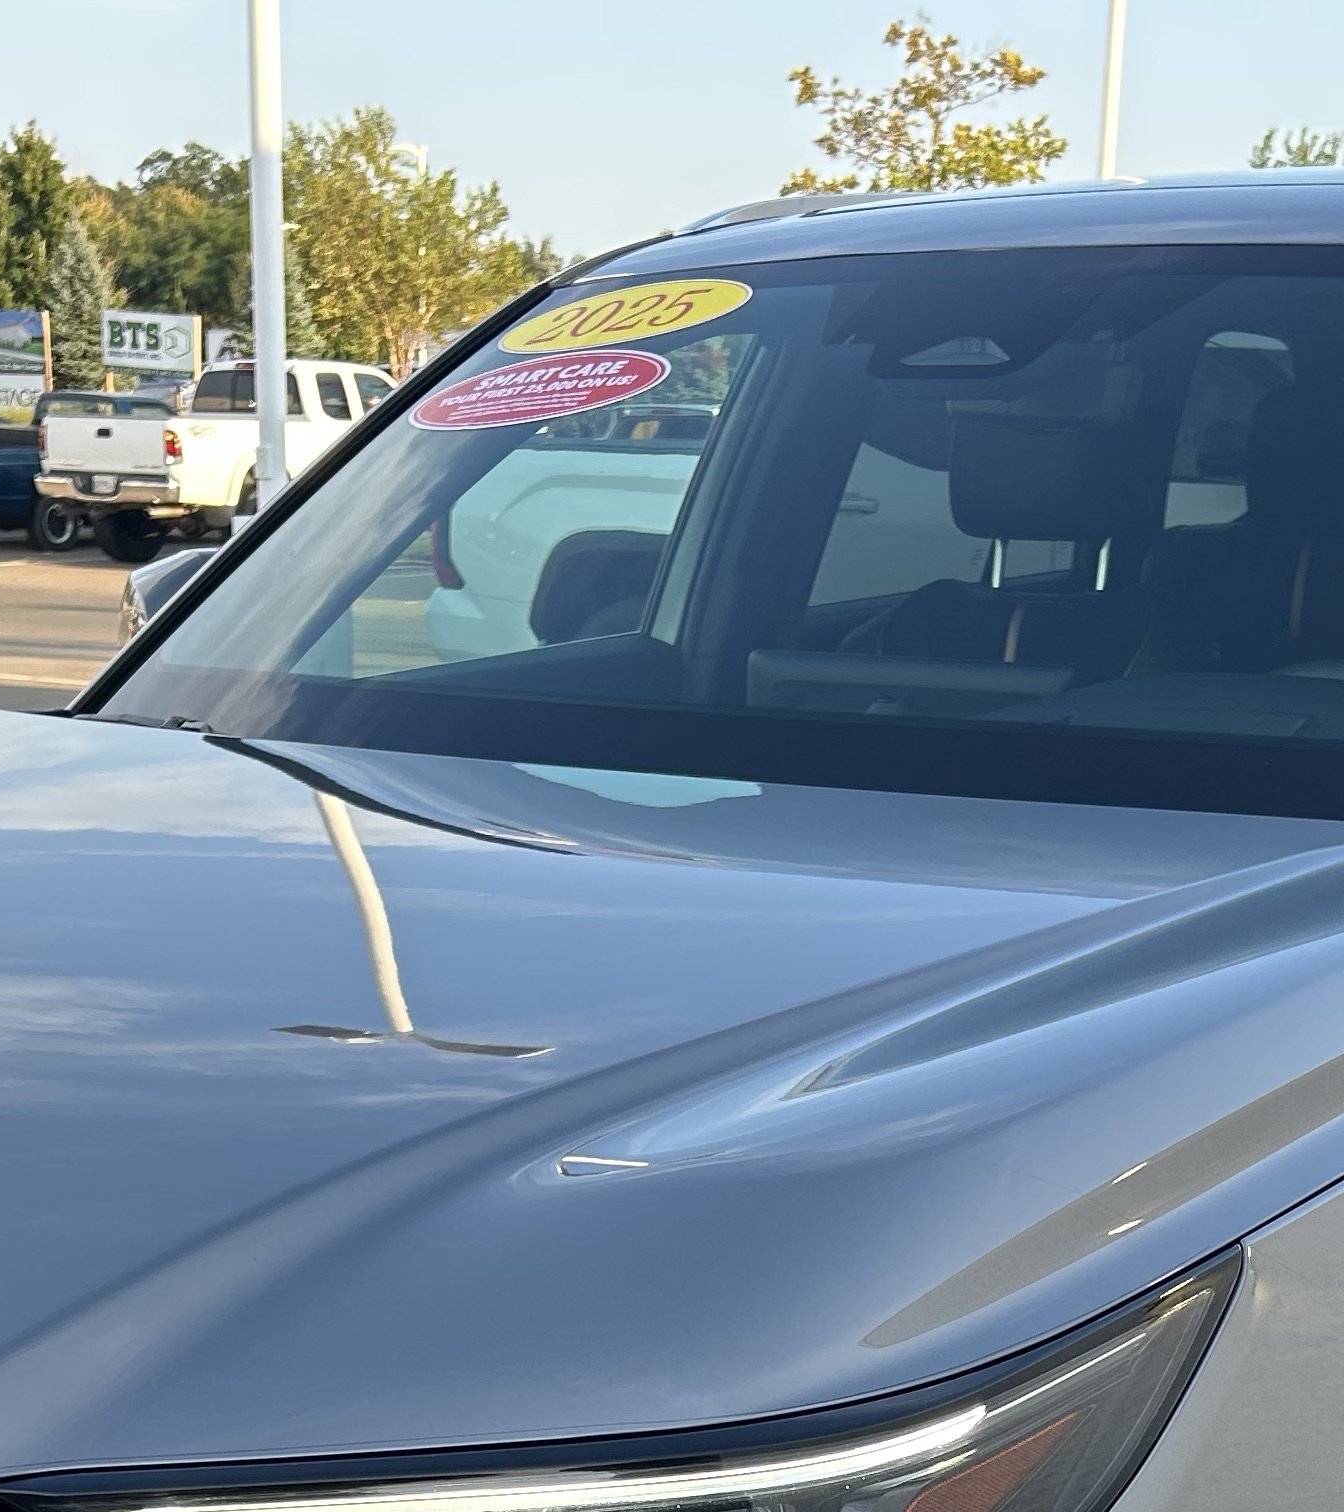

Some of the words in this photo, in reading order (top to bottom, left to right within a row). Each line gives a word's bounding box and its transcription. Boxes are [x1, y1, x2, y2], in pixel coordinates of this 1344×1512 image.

[524, 288, 714, 346] 2025
[108, 320, 161, 351] BTS
[439, 390, 484, 407] YOUR
[482, 385, 526, 400] FIRST
[523, 379, 580, 396] 25,000
[578, 377, 607, 388] ON
[607, 374, 639, 387] US!
[473, 364, 559, 391] SMART
[557, 360, 630, 379] CARE
